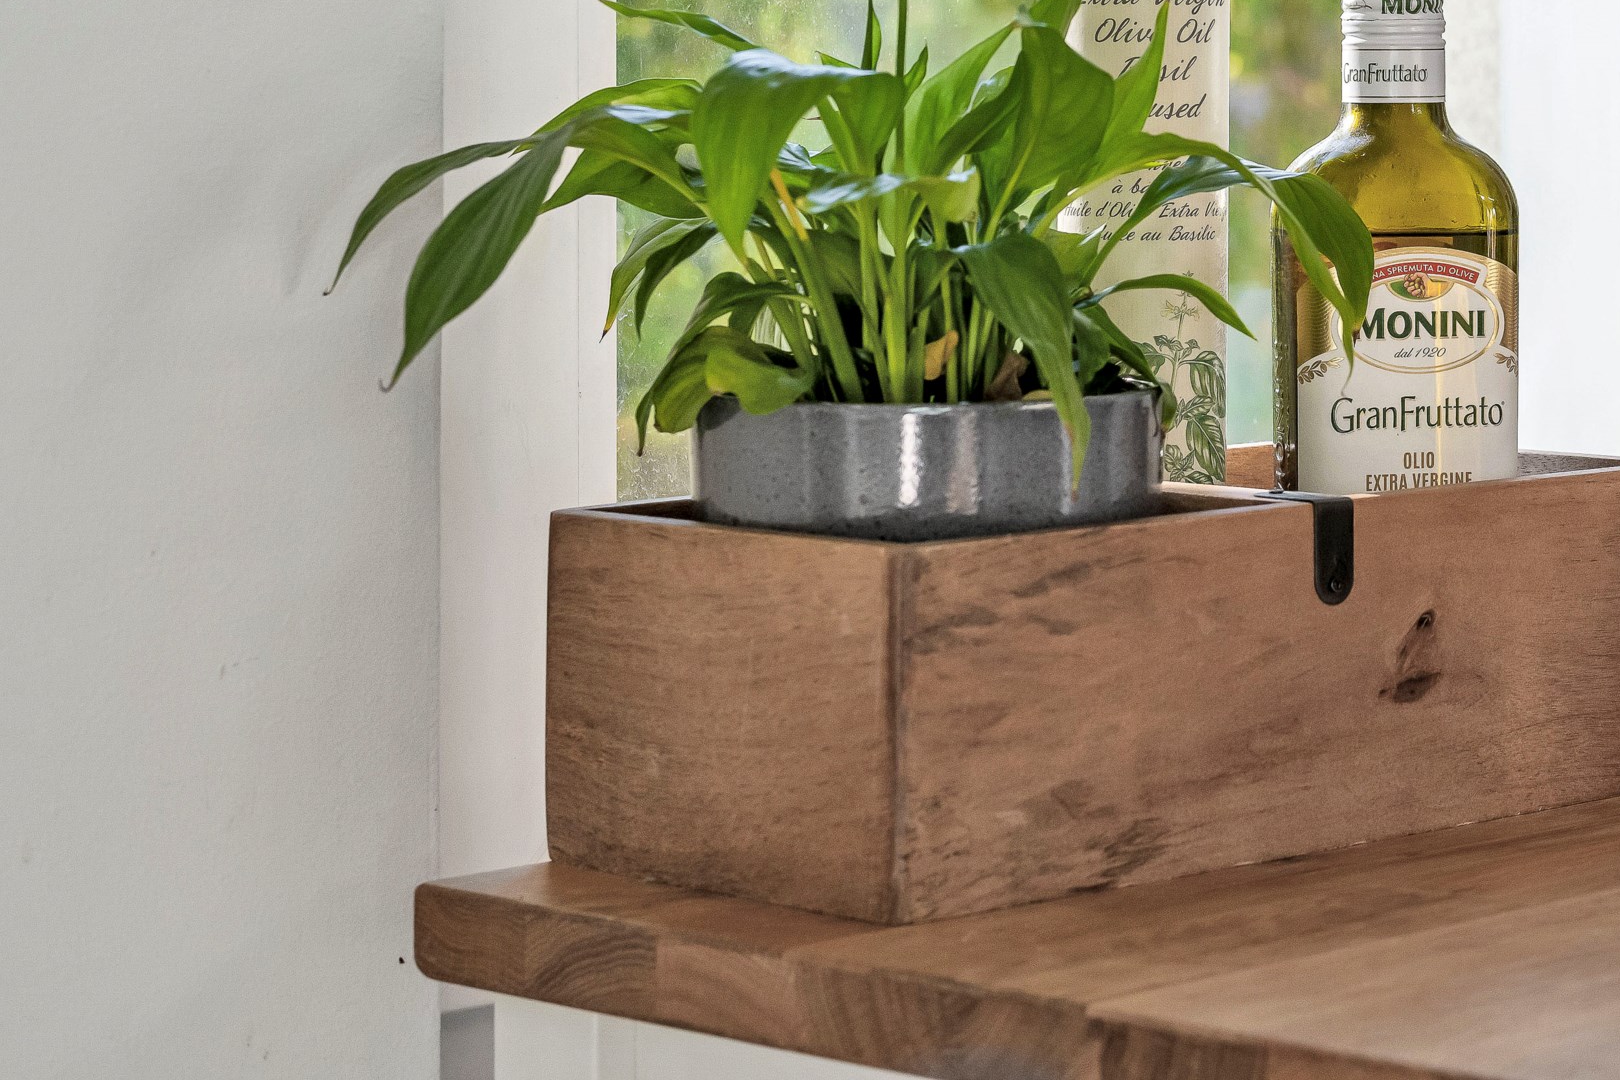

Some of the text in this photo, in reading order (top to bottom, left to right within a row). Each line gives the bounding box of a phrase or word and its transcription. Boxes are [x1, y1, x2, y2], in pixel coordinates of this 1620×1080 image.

[1176, 18, 1216, 44] Oil
[1343, 62, 1428, 85] GranFruttato
[1095, 201, 1136, 218] d'Oli
[1158, 201, 1199, 219] Extra
[1140, 231, 1162, 241] au
[1167, 224, 1216, 241] Basilic
[1386, 263, 1434, 274] SPREMUTA
[1436, 265, 1446, 274] DI
[1448, 266, 1476, 281] OLIVE
[1356, 307, 1486, 340] MONINI
[1393, 346, 1447, 359] dal 1920
[1330, 395, 1503, 434] GranFruttato
[1403, 451, 1435, 470] OLIO
[1365, 471, 1473, 492] EXTRA VERGINE
